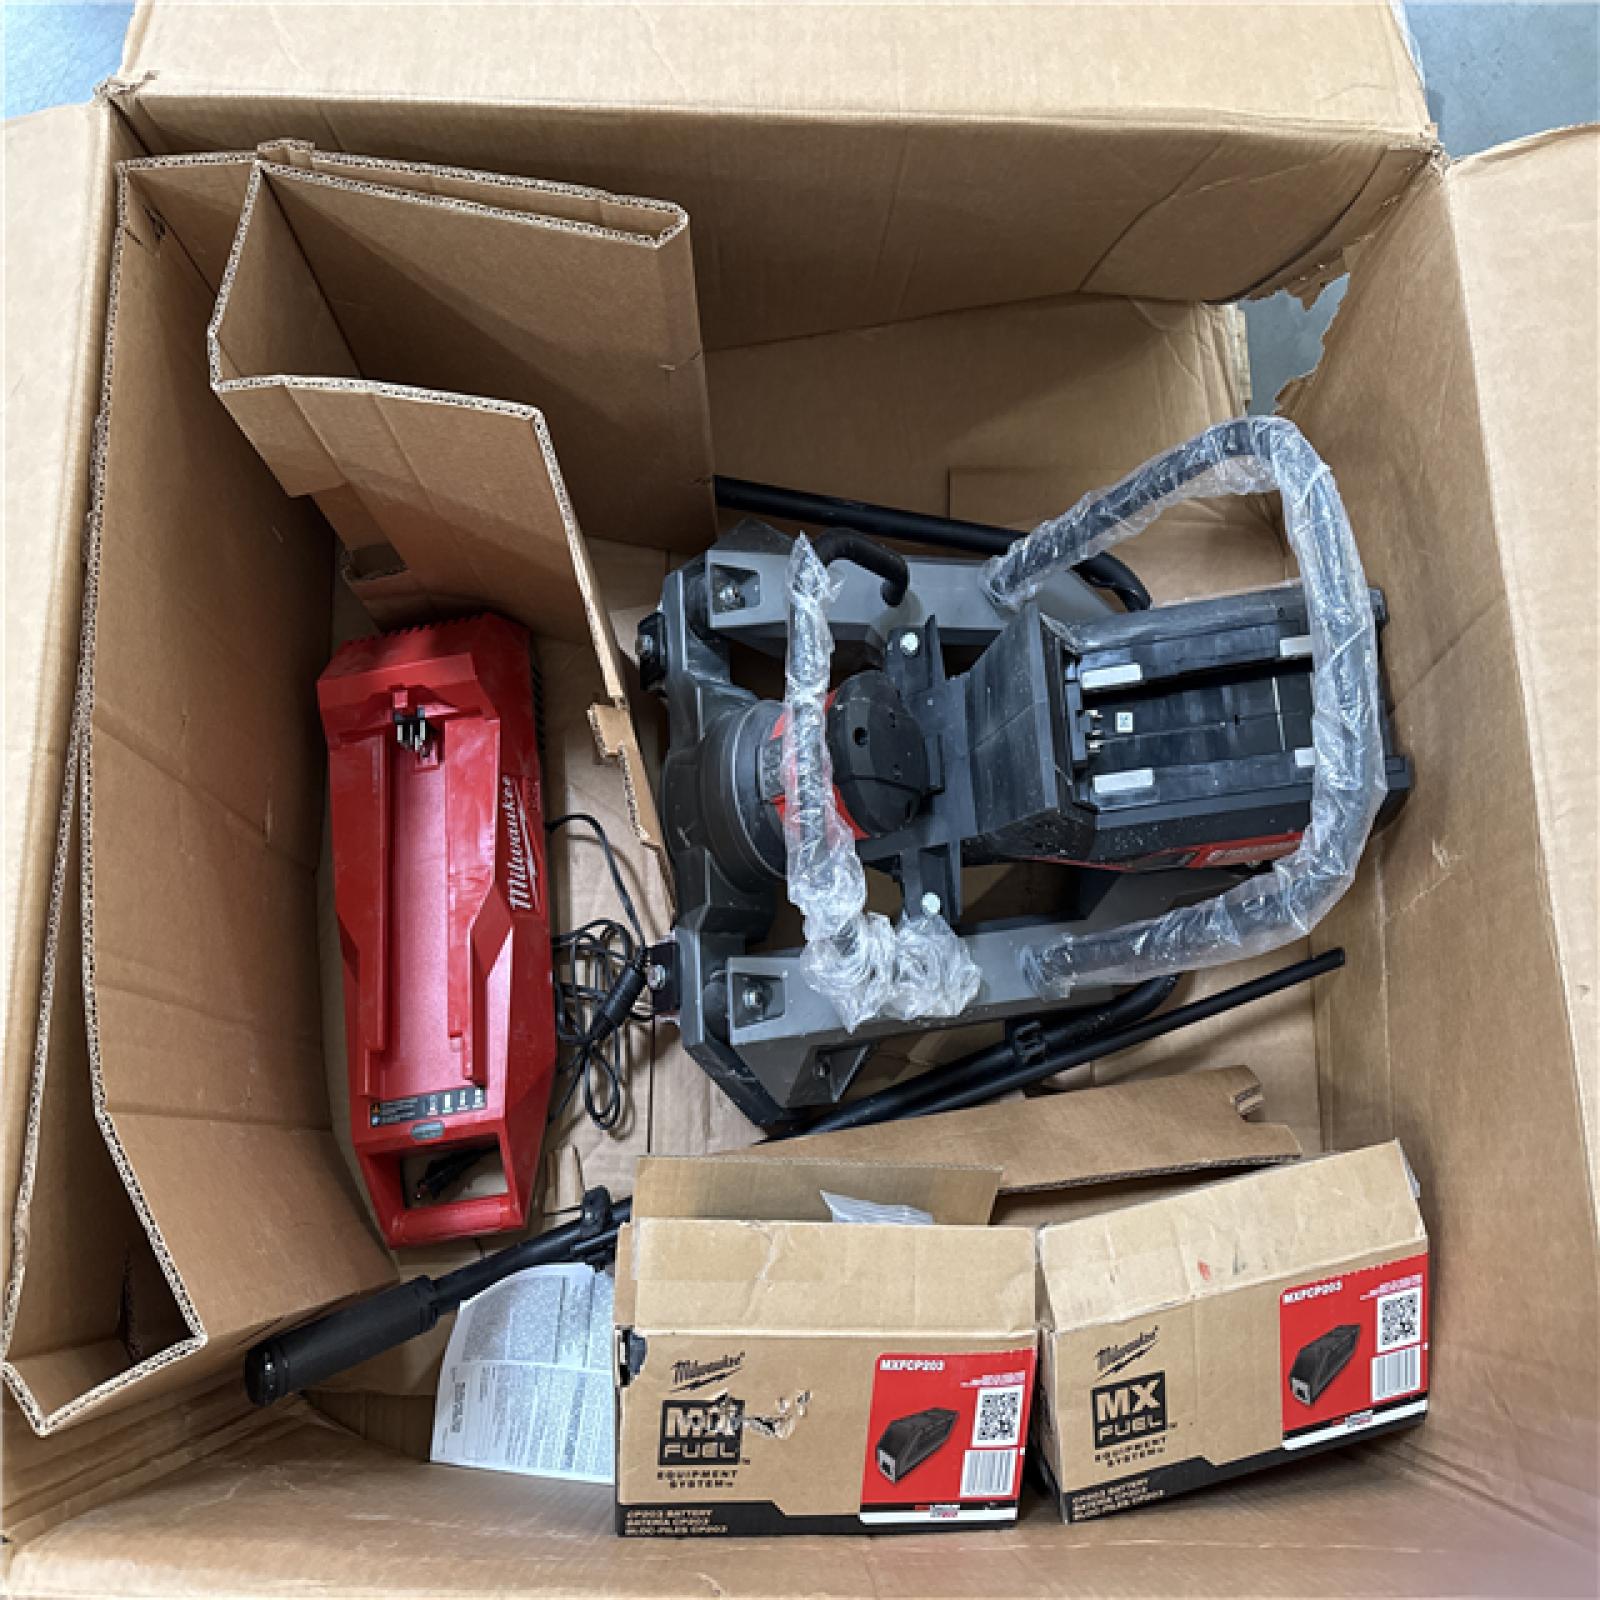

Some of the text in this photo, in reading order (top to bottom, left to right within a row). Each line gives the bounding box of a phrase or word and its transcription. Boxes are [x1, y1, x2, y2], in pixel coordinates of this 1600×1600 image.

[502, 775, 533, 910] Milwaukee
[1282, 1279, 1343, 1304] MXFCP203
[1093, 1330, 1157, 1371] Milwaukee
[671, 1355, 742, 1384] Milwaukee
[879, 1359, 945, 1371] MXFCP203
[1096, 1379, 1161, 1421] MX
[1099, 1415, 1163, 1441] FUEL
[664, 1443, 737, 1459] FUEL
[1094, 1436, 1166, 1462] EQUIPMENT
[657, 1469, 738, 1480] EQUIPMENT
[667, 1509, 713, 1517] BATTERY
